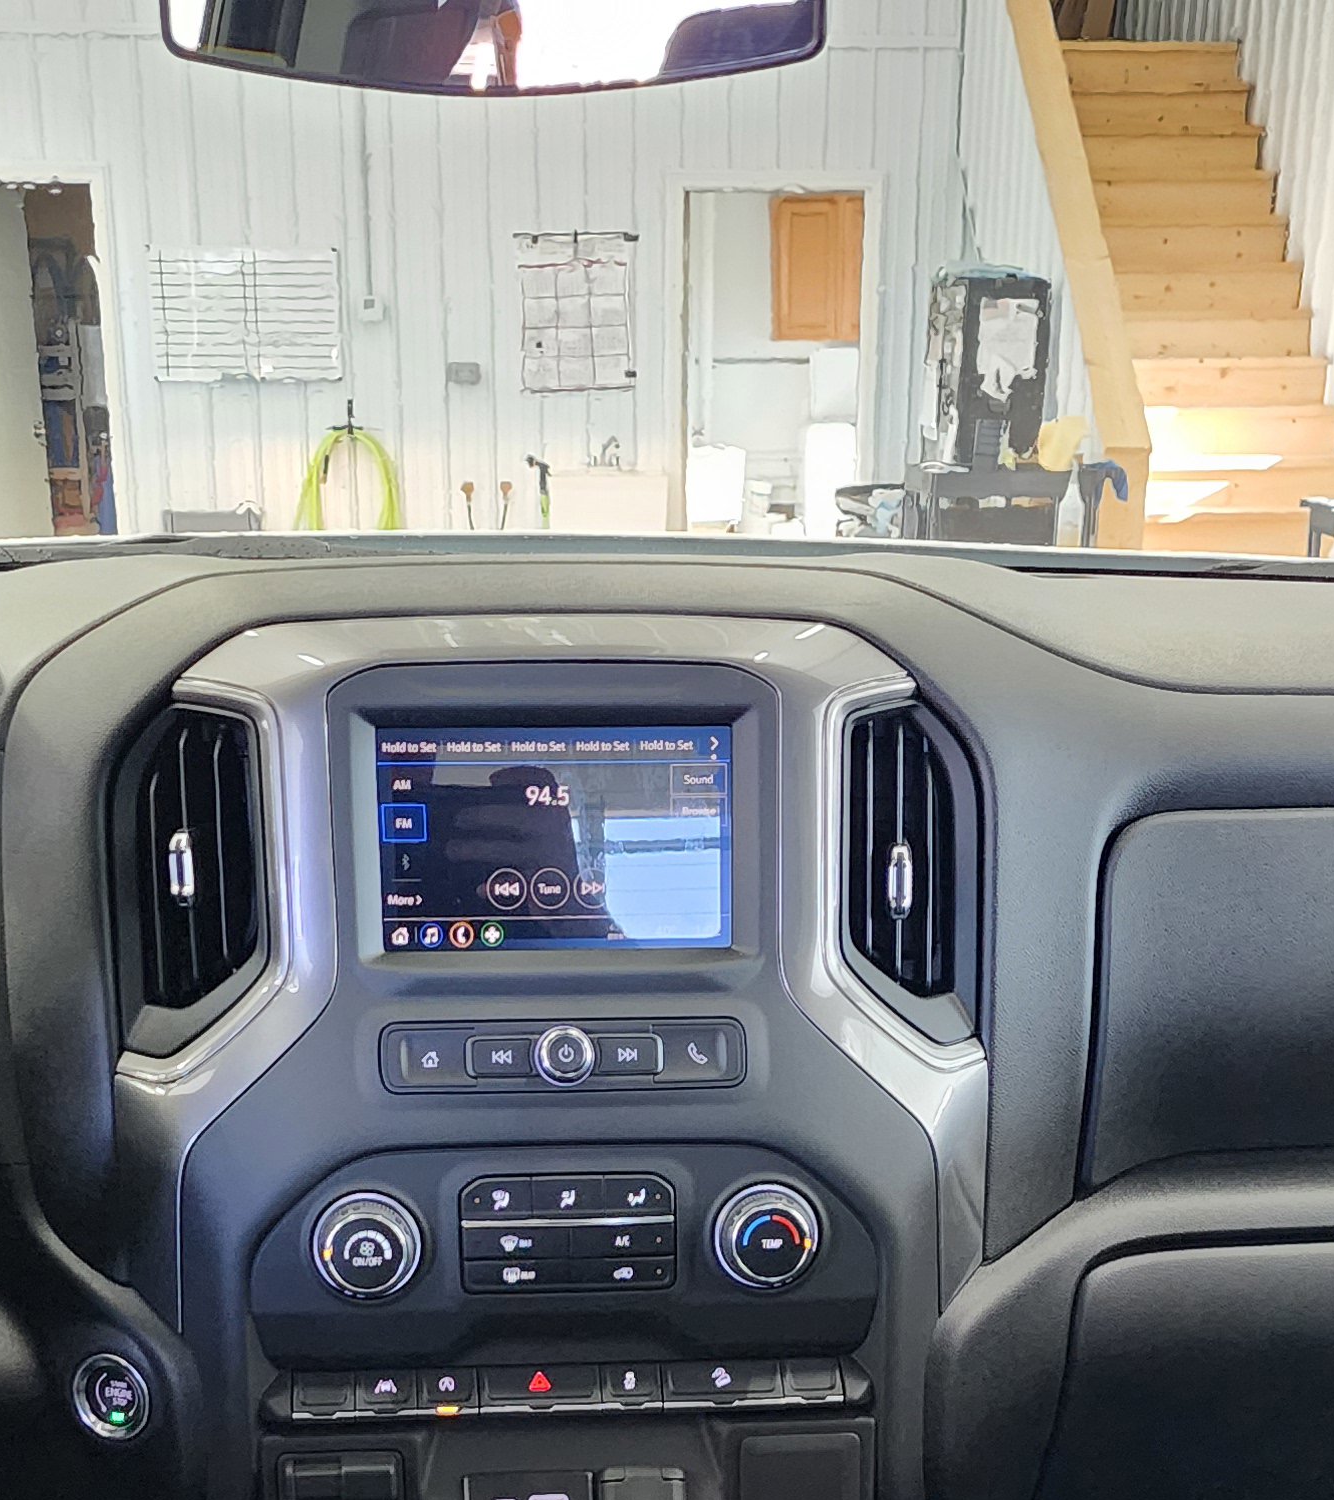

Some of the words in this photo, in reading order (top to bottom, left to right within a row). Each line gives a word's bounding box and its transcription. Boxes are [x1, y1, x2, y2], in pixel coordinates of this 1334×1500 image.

[381, 742, 407, 753] Hold
[408, 743, 418, 753] to
[418, 742, 437, 753] Set
[447, 741, 471, 753] Hold
[472, 742, 483, 753] to
[485, 741, 502, 753] Set
[511, 741, 536, 753] Hold
[537, 742, 548, 753] to
[549, 741, 567, 753] Set
[576, 741, 600, 752] Hold
[601, 742, 612, 752] to
[613, 741, 630, 752] Set
[640, 740, 664, 751] Hold
[665, 741, 676, 751] to
[677, 740, 694, 751] Set
[392, 779, 412, 790] AM
[683, 775, 714, 785] Sound
[525, 786, 570, 806] 94.5
[395, 818, 413, 829] FM
[537, 883, 562, 895] Tune
[387, 895, 415, 906] More
